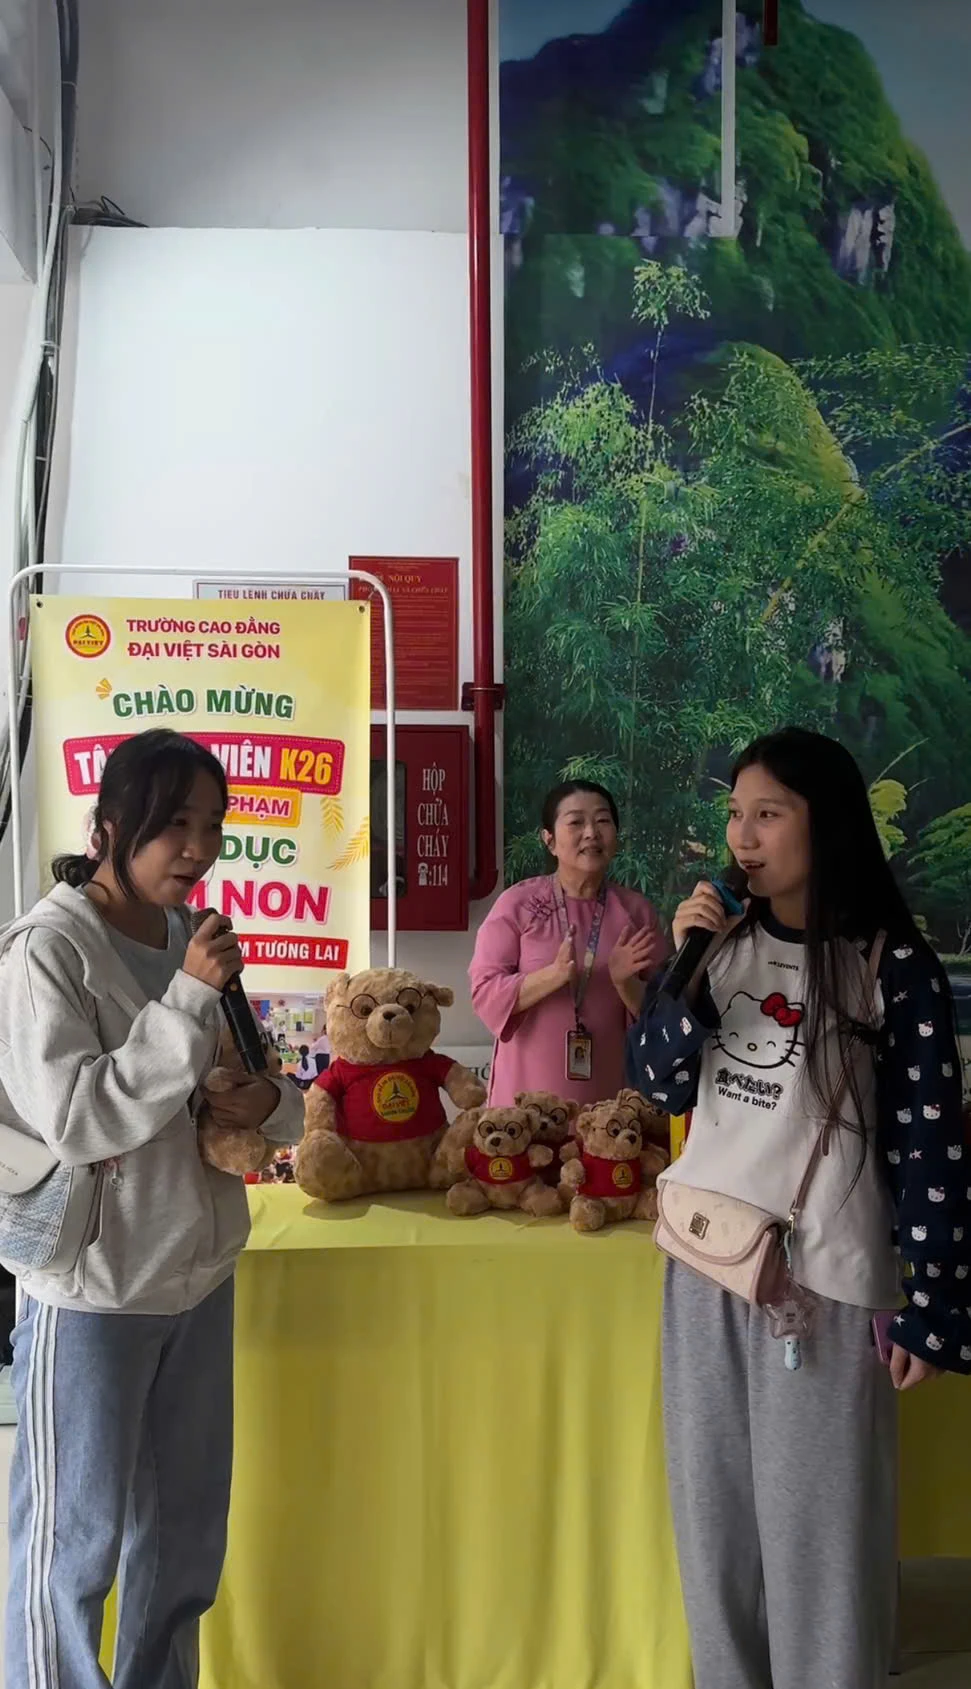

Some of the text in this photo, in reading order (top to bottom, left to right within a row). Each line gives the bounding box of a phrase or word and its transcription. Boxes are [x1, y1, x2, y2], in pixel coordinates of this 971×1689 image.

[127, 616, 280, 634] TRƯỜNG CAO ĐẲNG
[128, 640, 280, 661] ĐẠI VIỆT SÀI GÒN
[113, 684, 293, 718] CHÀO MỪNG
[74, 739, 333, 785] TÂ VIÊN K26
[422, 761, 445, 796] HỘP
[227, 795, 290, 818] PHẠM
[219, 835, 296, 868] DỤC
[417, 828, 449, 857] CHÁY
[222, 880, 329, 921] NON
[256, 940, 309, 959] TƯƠNG
[315, 944, 339, 961] LAI
[718, 1086, 741, 1101] Want
[752, 1096, 777, 1110] bite?
